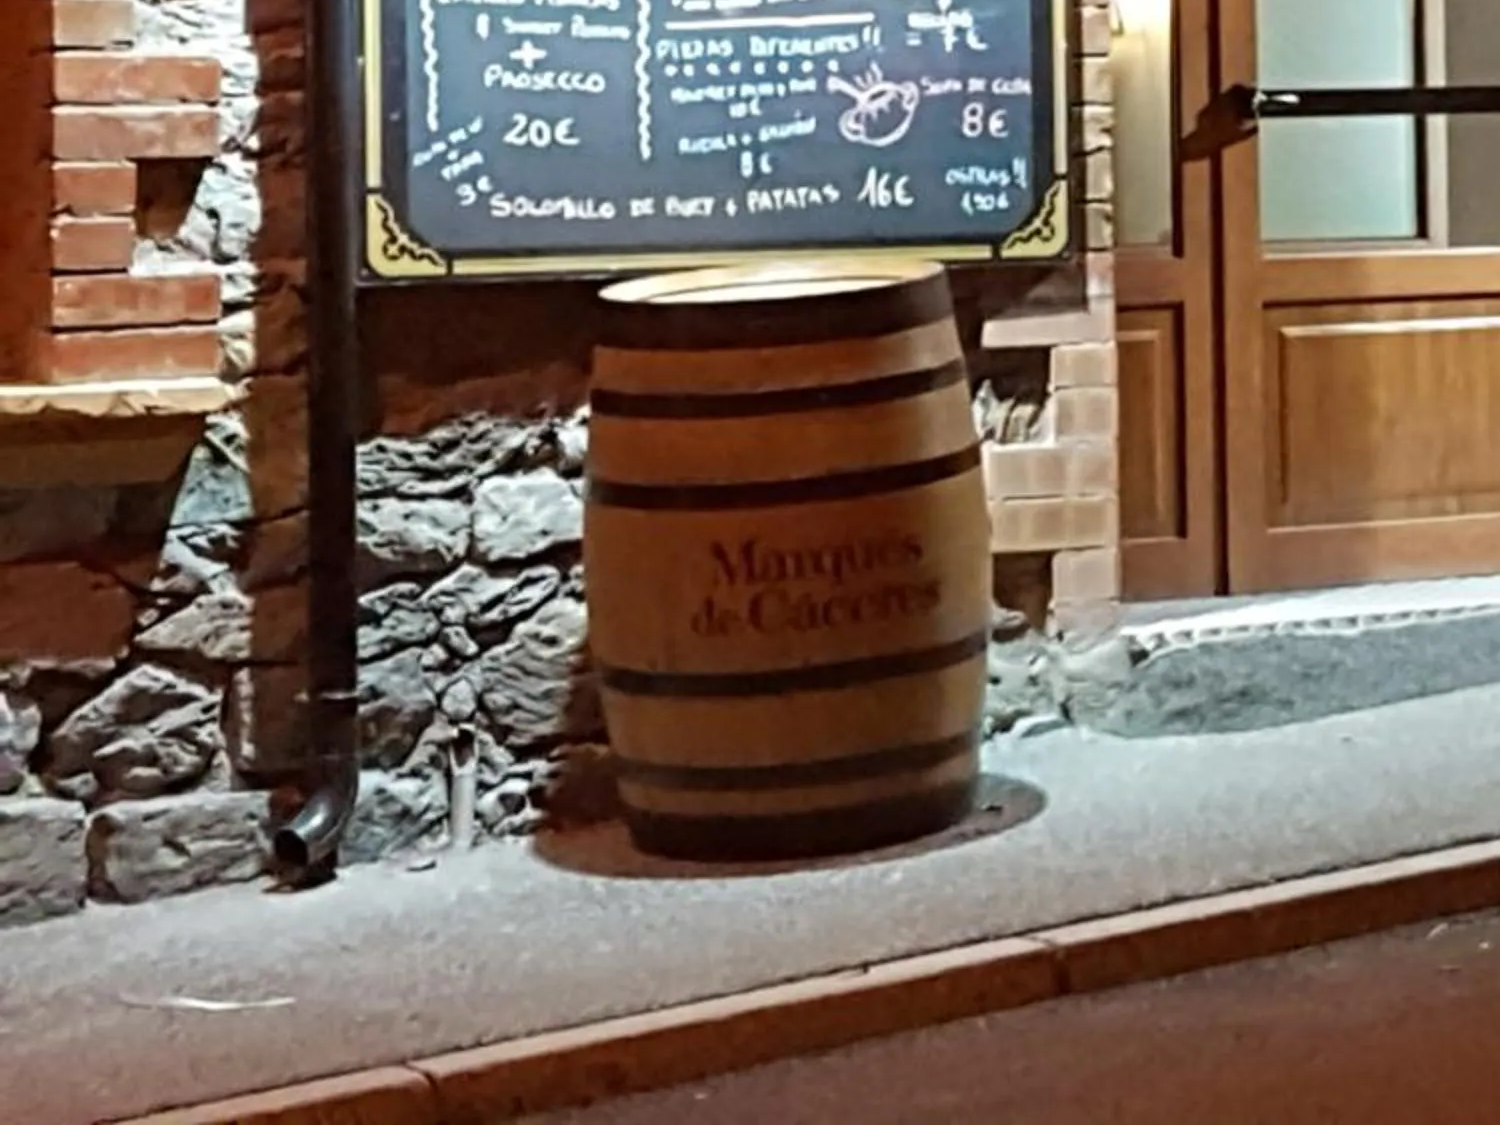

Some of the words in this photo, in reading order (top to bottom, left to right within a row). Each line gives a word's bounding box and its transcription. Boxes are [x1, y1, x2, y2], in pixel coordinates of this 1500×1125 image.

[483, 63, 606, 93] PROSECCO
[502, 112, 580, 148] 20€
[961, 102, 1010, 138] 8€
[747, 183, 841, 215] PATATAS
[858, 166, 915, 209] 16€
